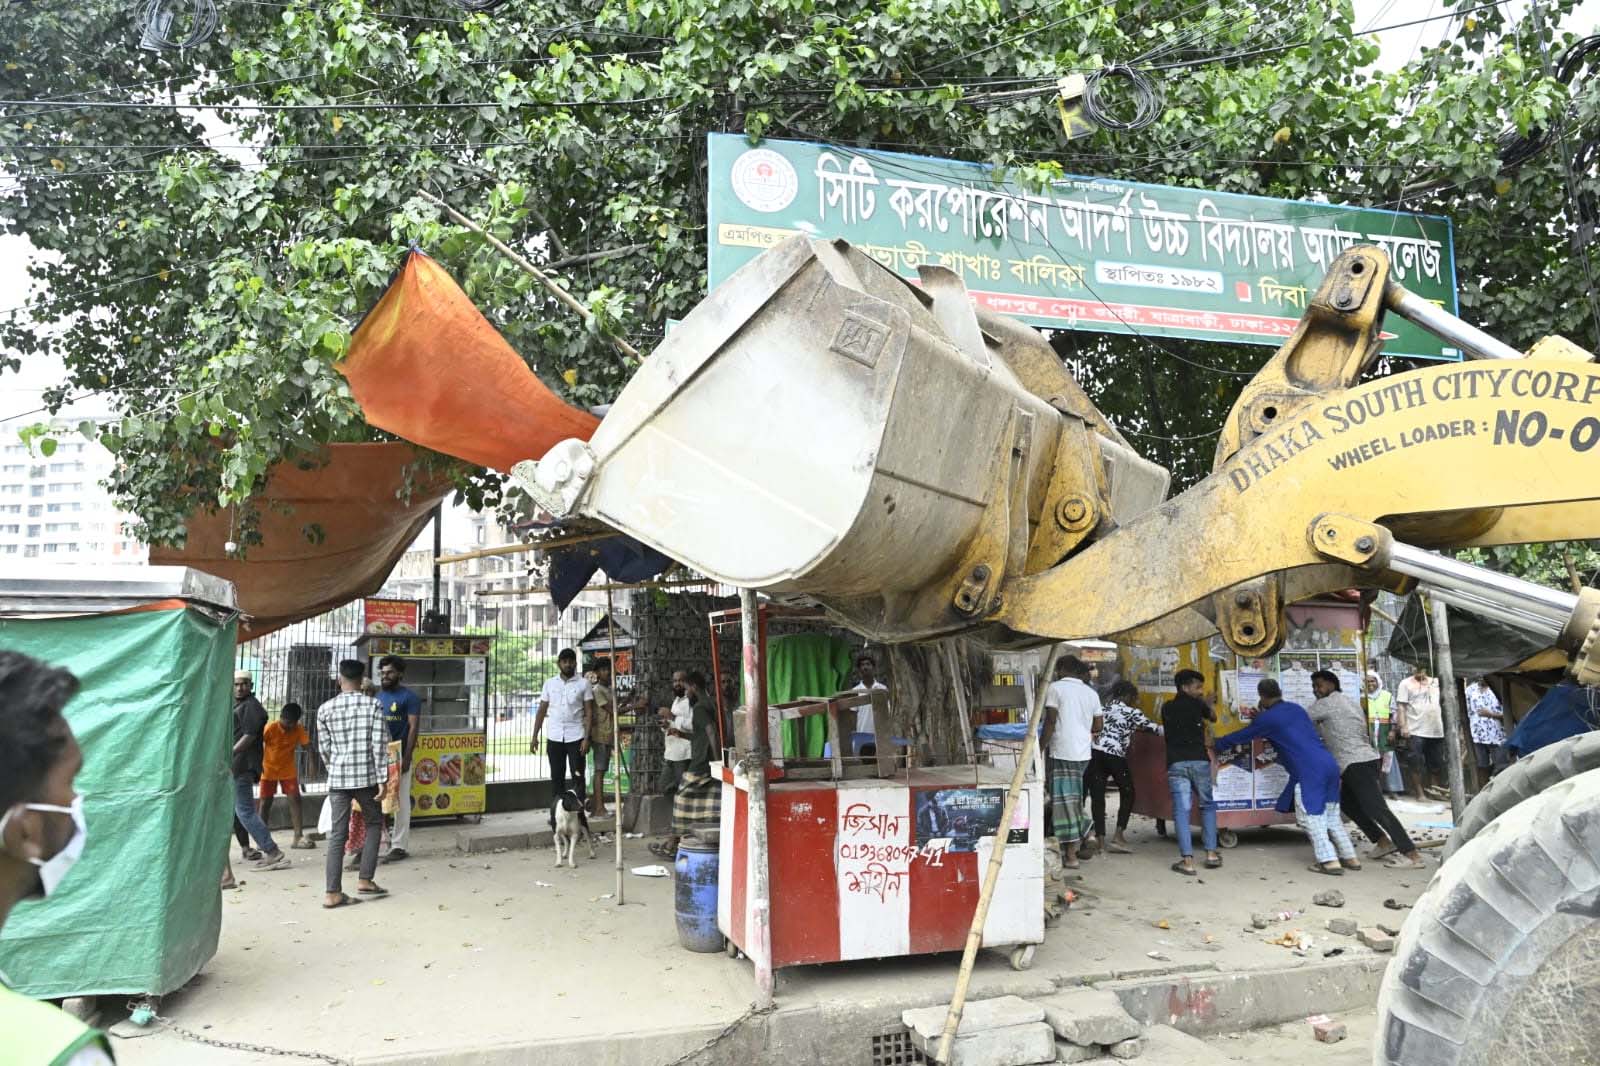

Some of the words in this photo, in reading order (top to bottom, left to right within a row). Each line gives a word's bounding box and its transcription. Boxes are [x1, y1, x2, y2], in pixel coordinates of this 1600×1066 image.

[815, 152, 879, 224] সিটি
[885, 179, 1051, 246] করপোরেশন
[1056, 189, 1134, 255] আদর্শ
[1139, 192, 1191, 256] উচ্চ
[1196, 198, 1296, 272] বিদ্যালয়
[1008, 254, 1086, 289] বালিকা
[1103, 264, 1164, 283] স্থাপিতঃ
[1171, 275, 1218, 291] ১৯৮২
[1257, 276, 1308, 310] দিবা
[1228, 419, 1324, 494] DHAKA
[1323, 377, 1427, 435] SOUTH
[1432, 368, 1512, 402] CITY
[1327, 436, 1397, 471] WHEEL
[422, 737, 446, 749] FOOD
[448, 735, 485, 749] CORNER
